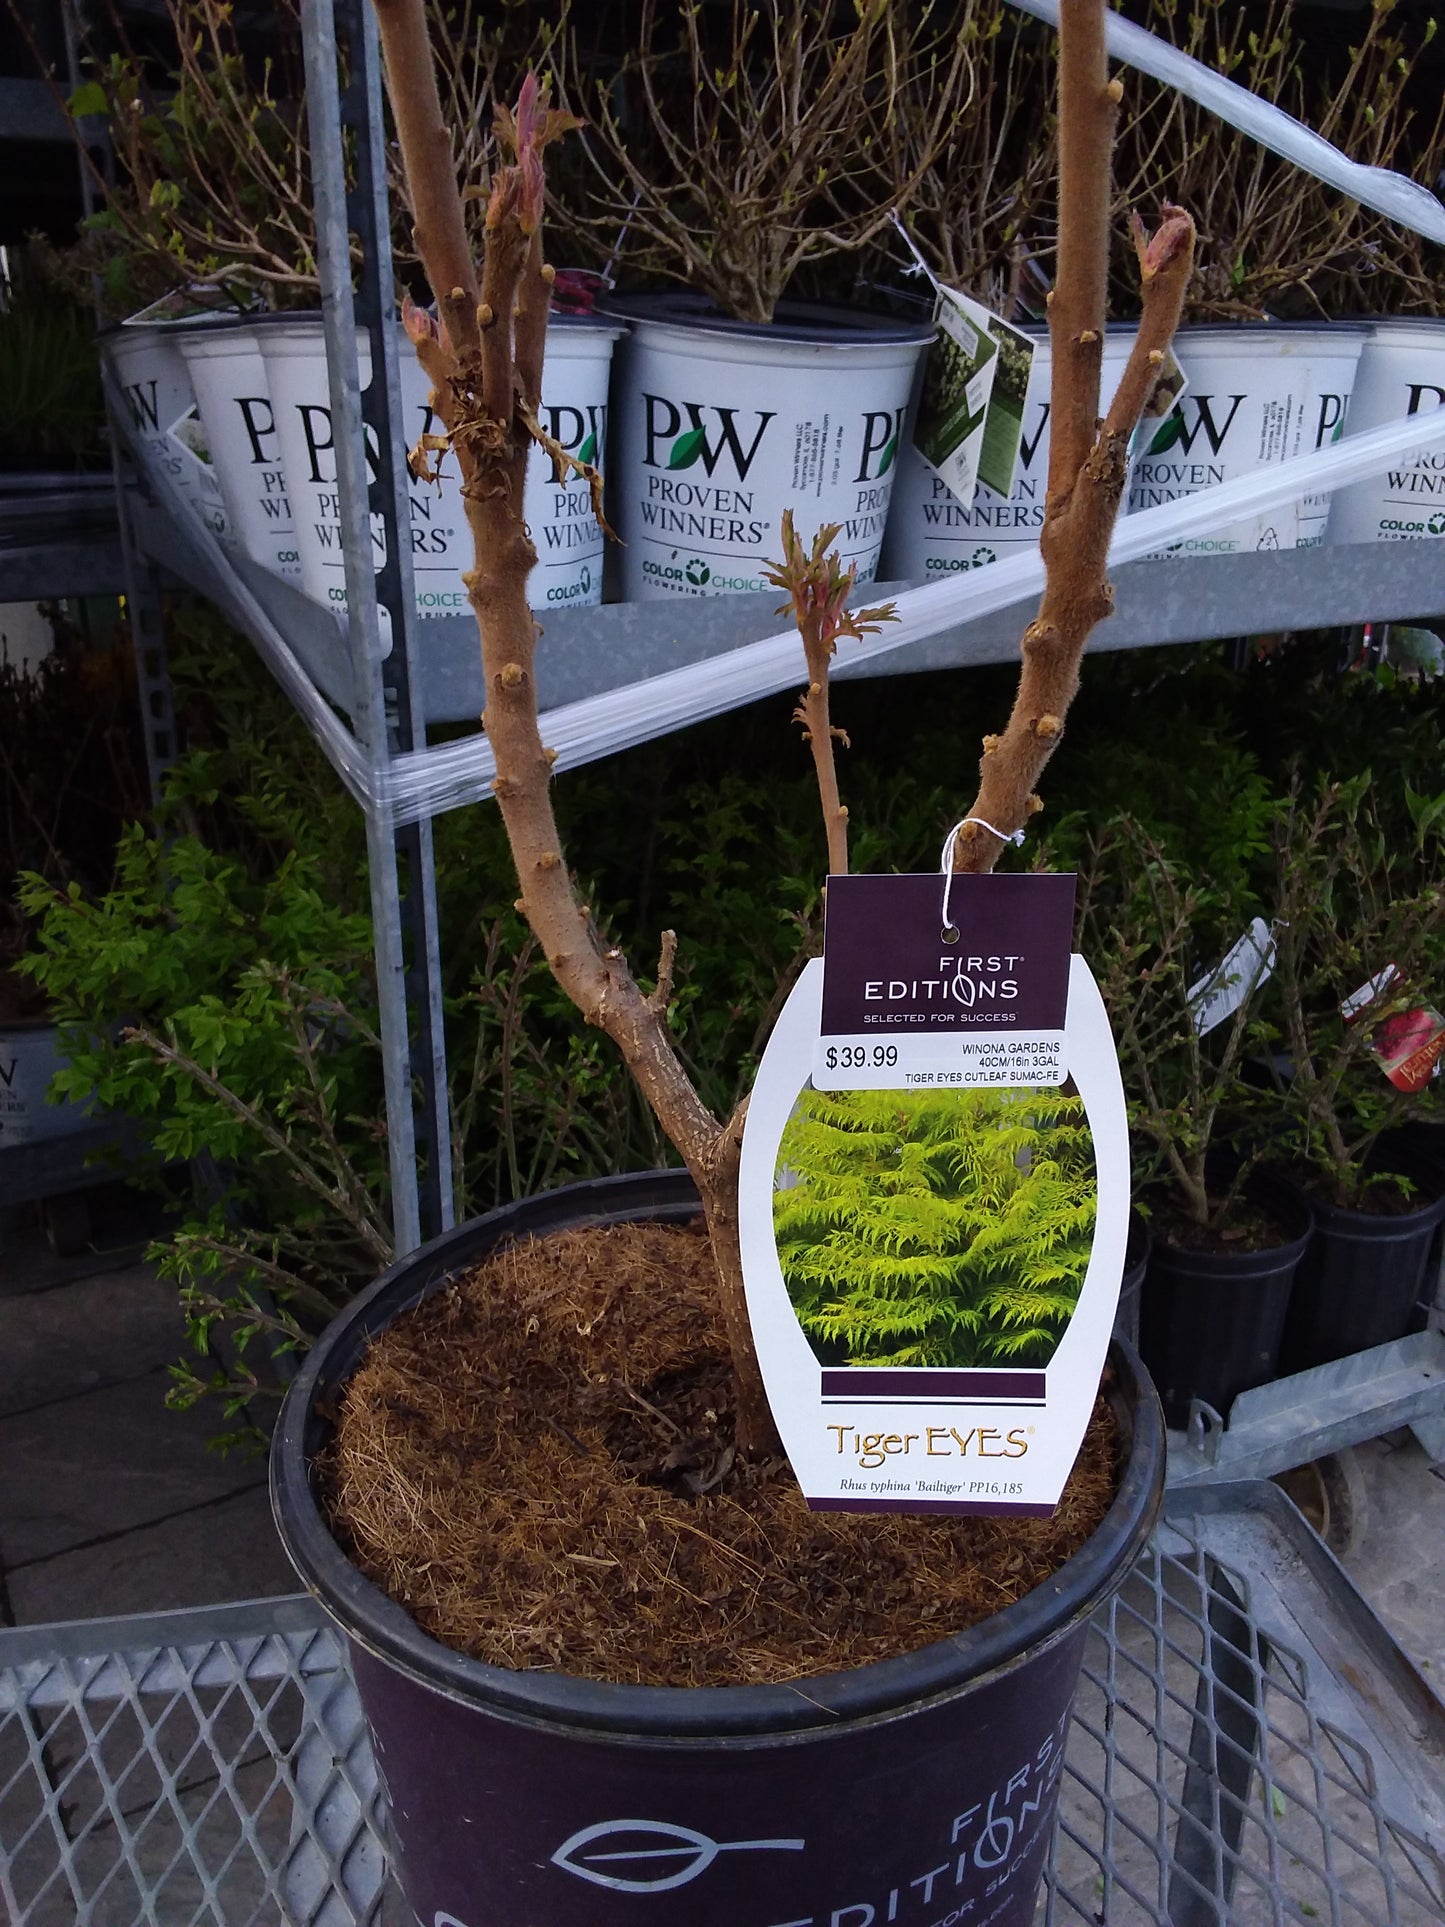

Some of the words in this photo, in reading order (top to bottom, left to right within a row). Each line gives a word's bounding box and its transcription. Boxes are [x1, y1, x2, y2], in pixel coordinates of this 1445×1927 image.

[233, 398, 277, 463] P
[642, 393, 777, 482] PW
[649, 476, 754, 513] PROVEN
[641, 502, 764, 544] WINNERS
[923, 504, 1044, 527] WINNERS
[1379, 519, 1425, 532] COLOR
[1185, 540, 1236, 551] CHOICE
[925, 558, 969, 571] COLOR
[643, 561, 683, 581] COLOR
[712, 576, 768, 591] CHOICE
[416, 593, 462, 606] HOICE
[940, 957, 1019, 972] FIRST
[865, 975, 1018, 1007] EDITIONS
[864, 1014, 925, 1023] SELECTED
[931, 1014, 955, 1022] FOR
[961, 1013, 1016, 1022] SUCCESS
[962, 1043, 1006, 1054] WINONA
[1008, 1042, 1060, 1053] GARDENS
[826, 1045, 898, 1069] $39.99
[1033, 1056, 1059, 1066] 3GAL
[905, 1073, 934, 1083] TIGER
[937, 1072, 962, 1082] EYES
[965, 1071, 1007, 1082] CUTLEAF
[1010, 1070, 1059, 1081] SUMAC-FE
[827, 1424, 919, 1468] Tiger
[926, 1426, 1028, 1458] EYES
[840, 1479, 867, 1491] Rhus
[870, 1479, 911, 1493] typhina
[915, 1479, 966, 1494] 'Bailtiger'
[969, 1481, 1023, 1495] PP16,185
